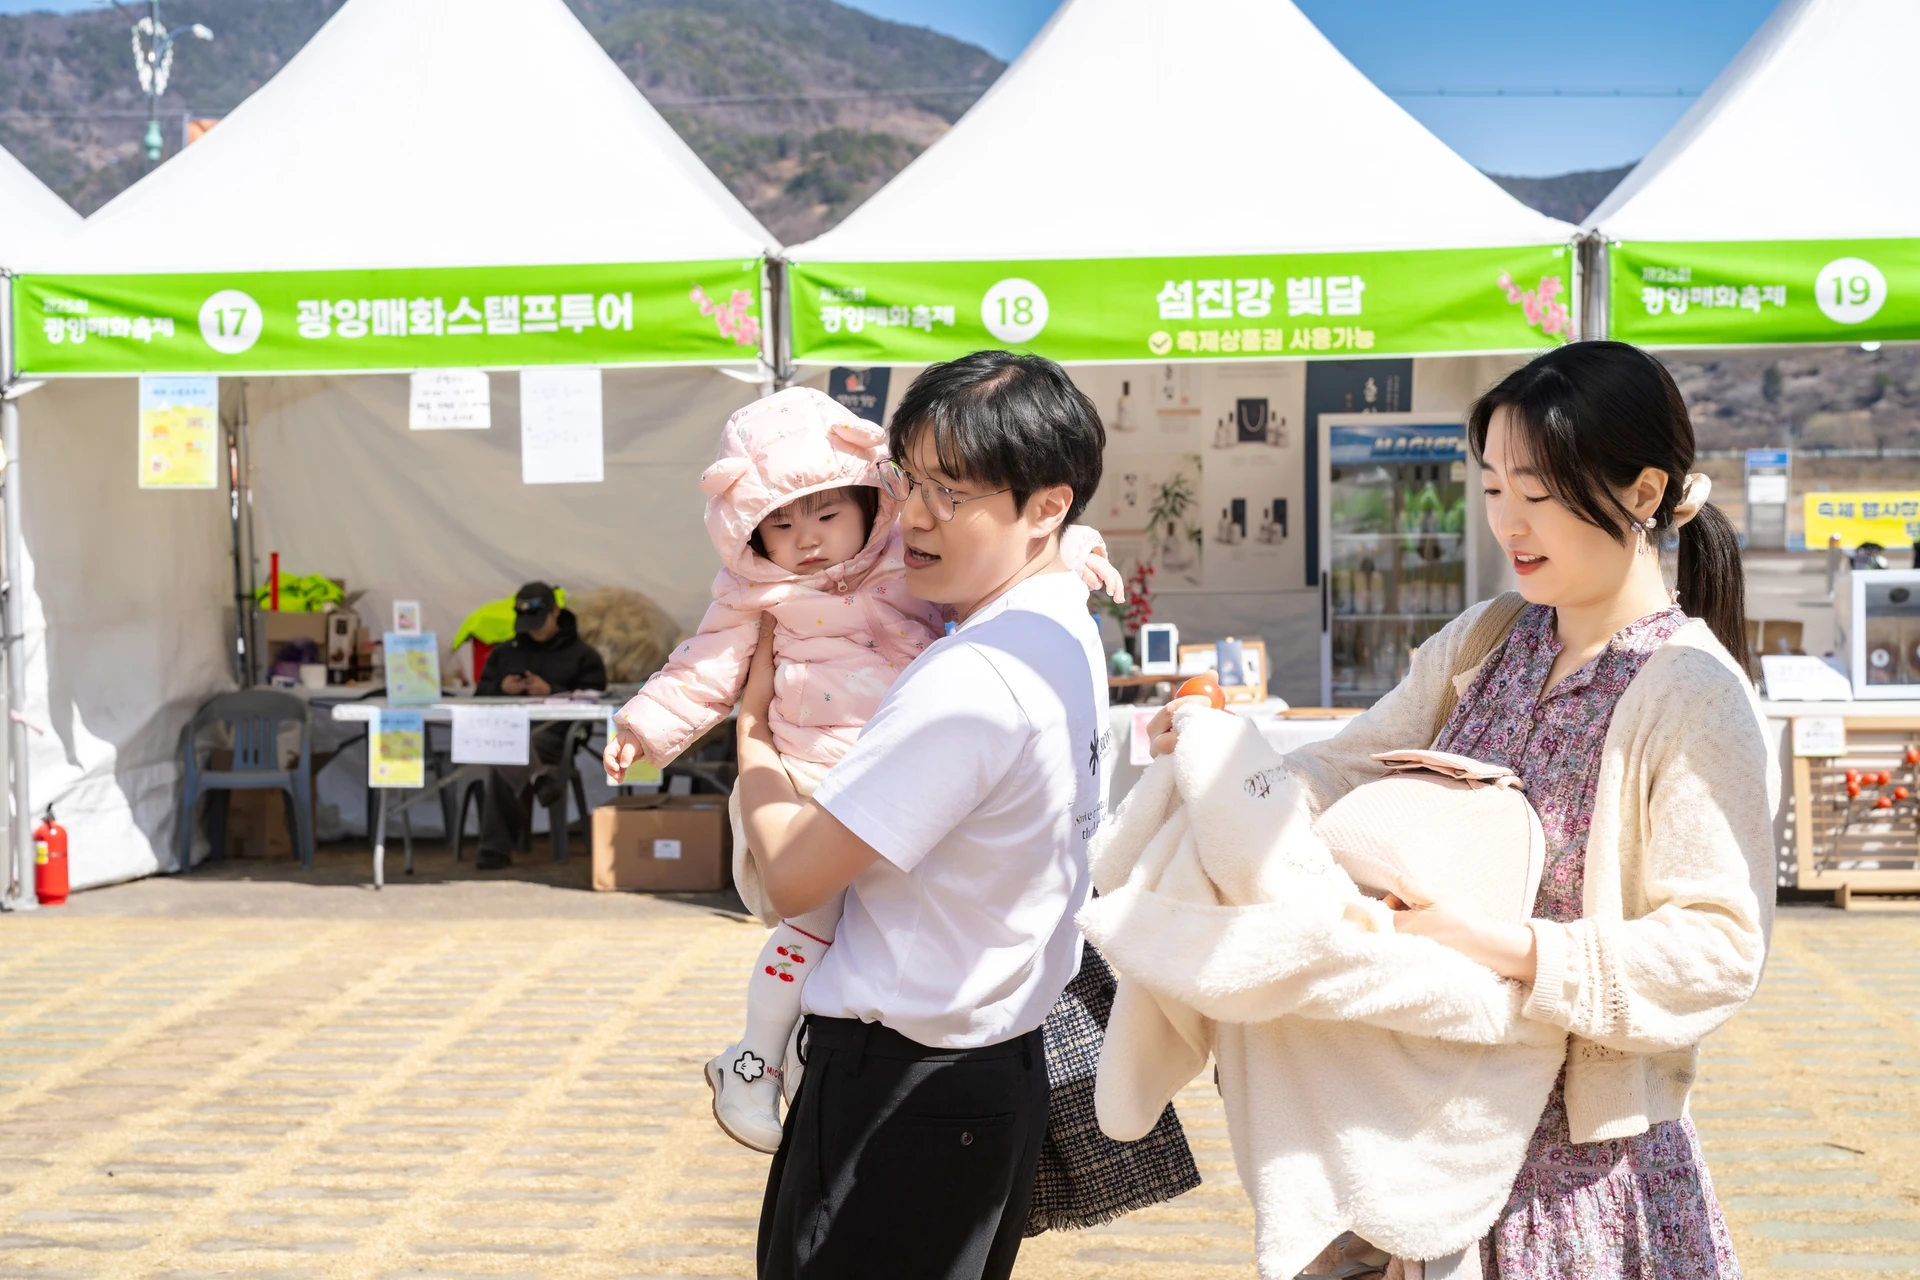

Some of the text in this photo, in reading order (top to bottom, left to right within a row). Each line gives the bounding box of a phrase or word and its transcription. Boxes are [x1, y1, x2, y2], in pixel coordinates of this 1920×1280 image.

[1156, 275, 1365, 319] 섬진강 빚담
[1641, 286, 1786, 315] 광양매화축제
[1831, 275, 1872, 305] 19
[213, 307, 249, 337] 17
[297, 293, 634, 339] 광양매화스탬프투어
[820, 305, 956, 334] 광양매화축제
[995, 296, 1034, 326] 18
[43, 317, 175, 345] 광양매화축제
[1177, 327, 1376, 352] 축제상품권 사용가능
